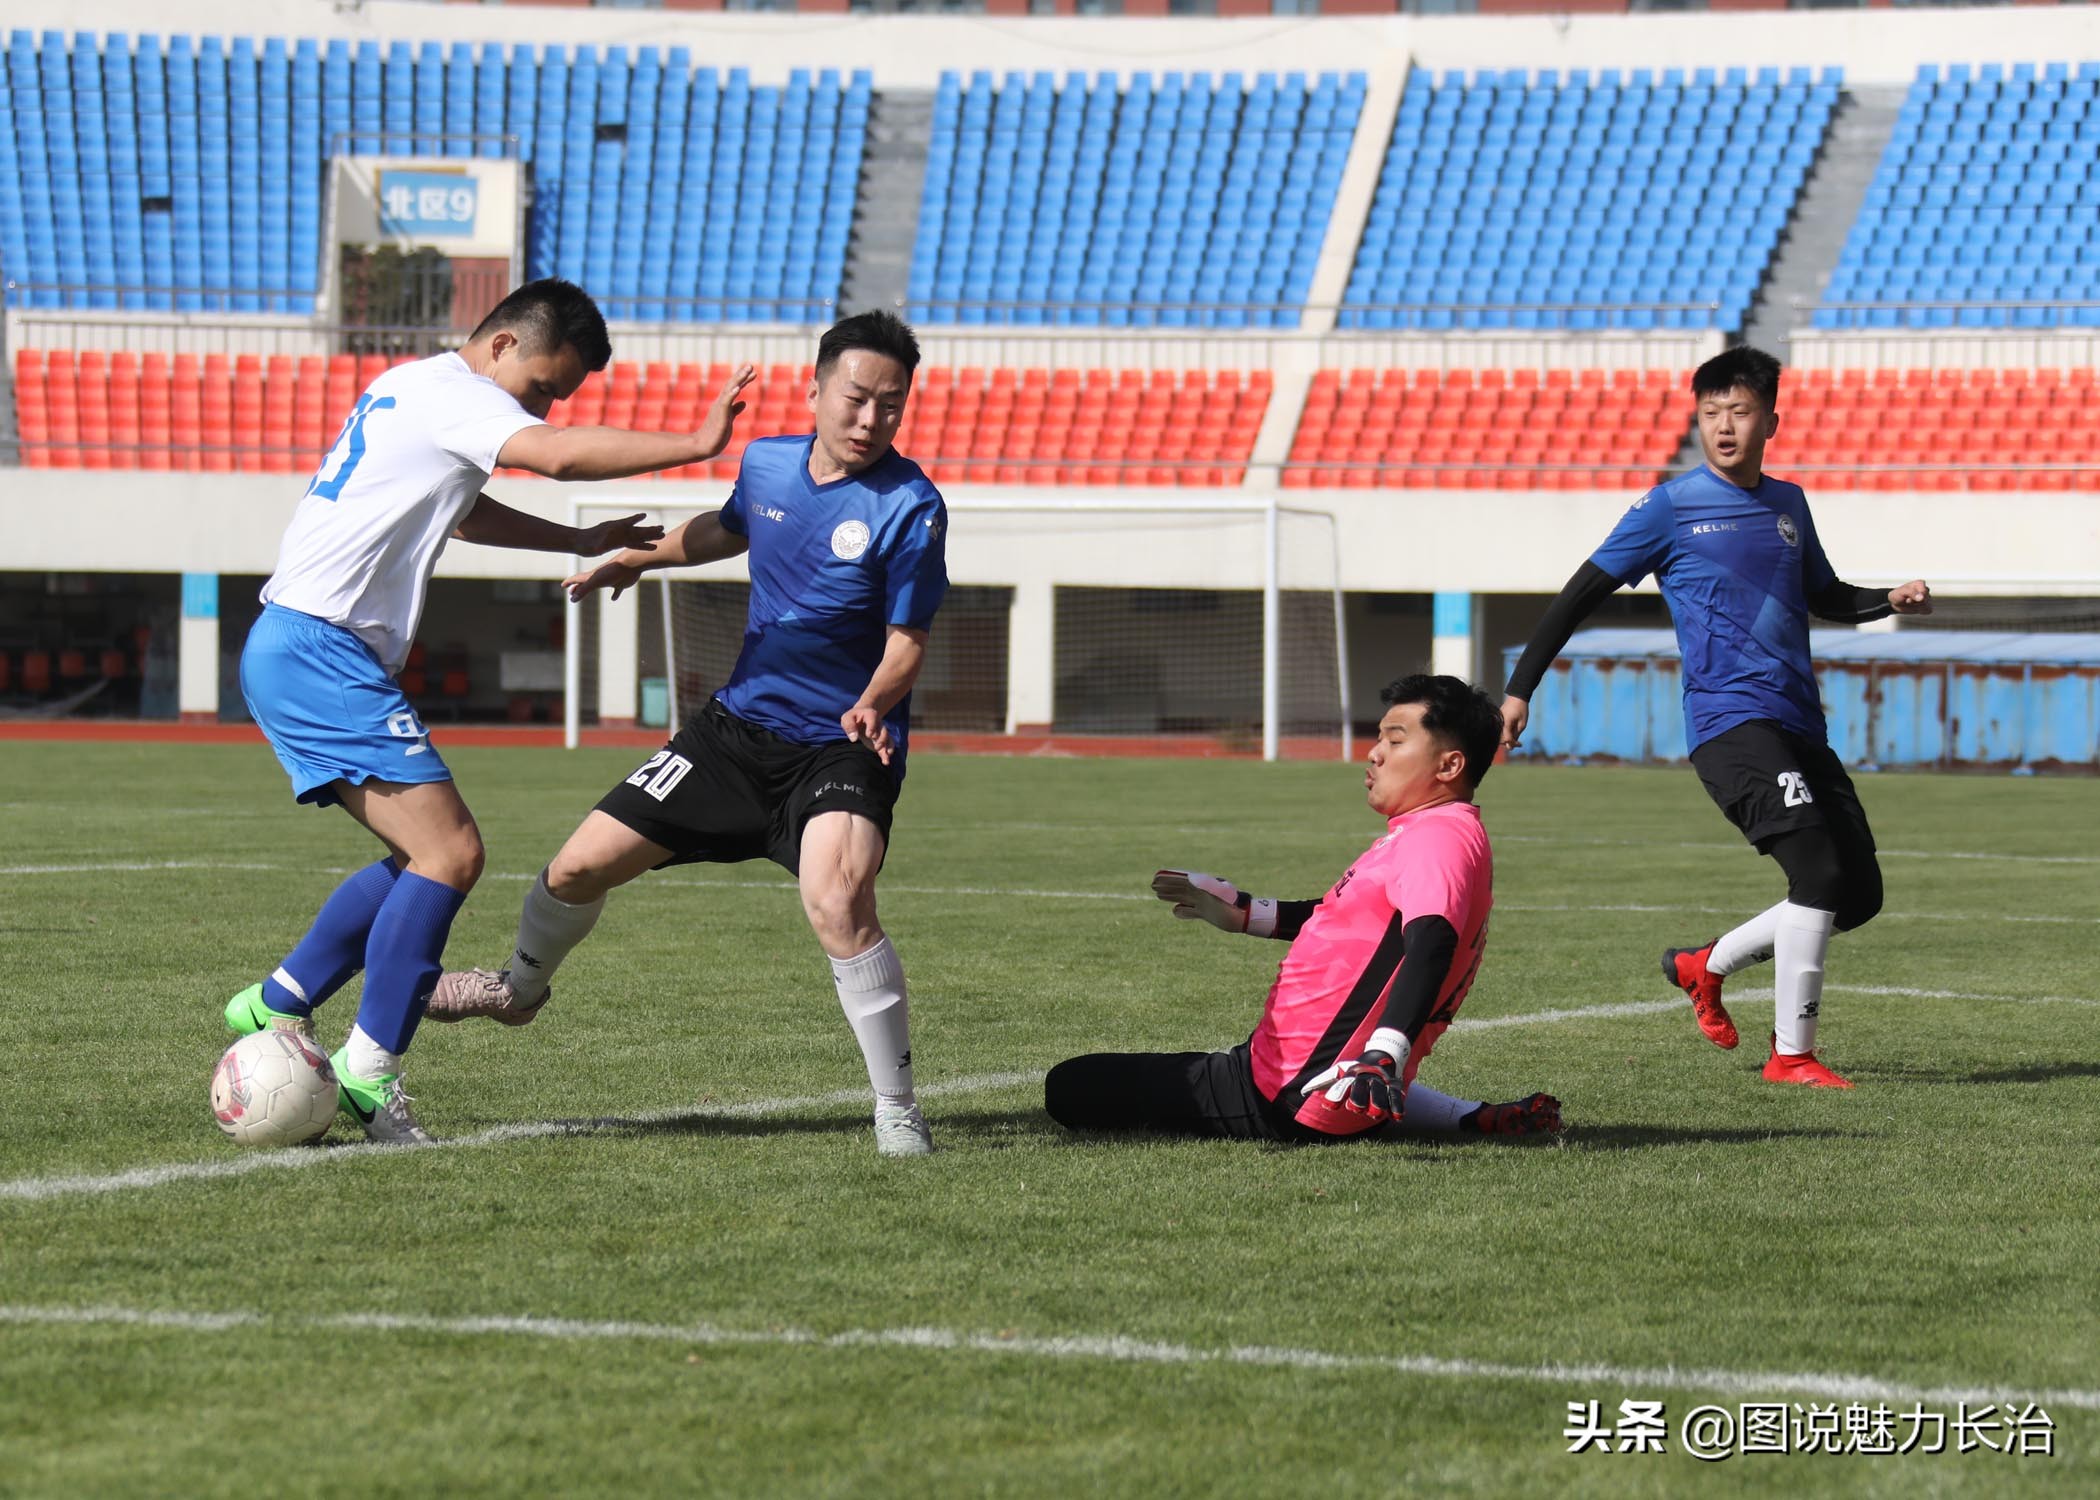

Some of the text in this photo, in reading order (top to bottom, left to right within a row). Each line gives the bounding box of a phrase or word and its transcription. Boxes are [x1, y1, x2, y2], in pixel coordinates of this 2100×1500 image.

[381, 186, 475, 222] 北区9
[752, 503, 785, 522] KELME
[1693, 523, 1739, 534] KELME
[625, 750, 694, 802] 20
[815, 781, 864, 798] KELME
[1777, 771, 1813, 808] 25
